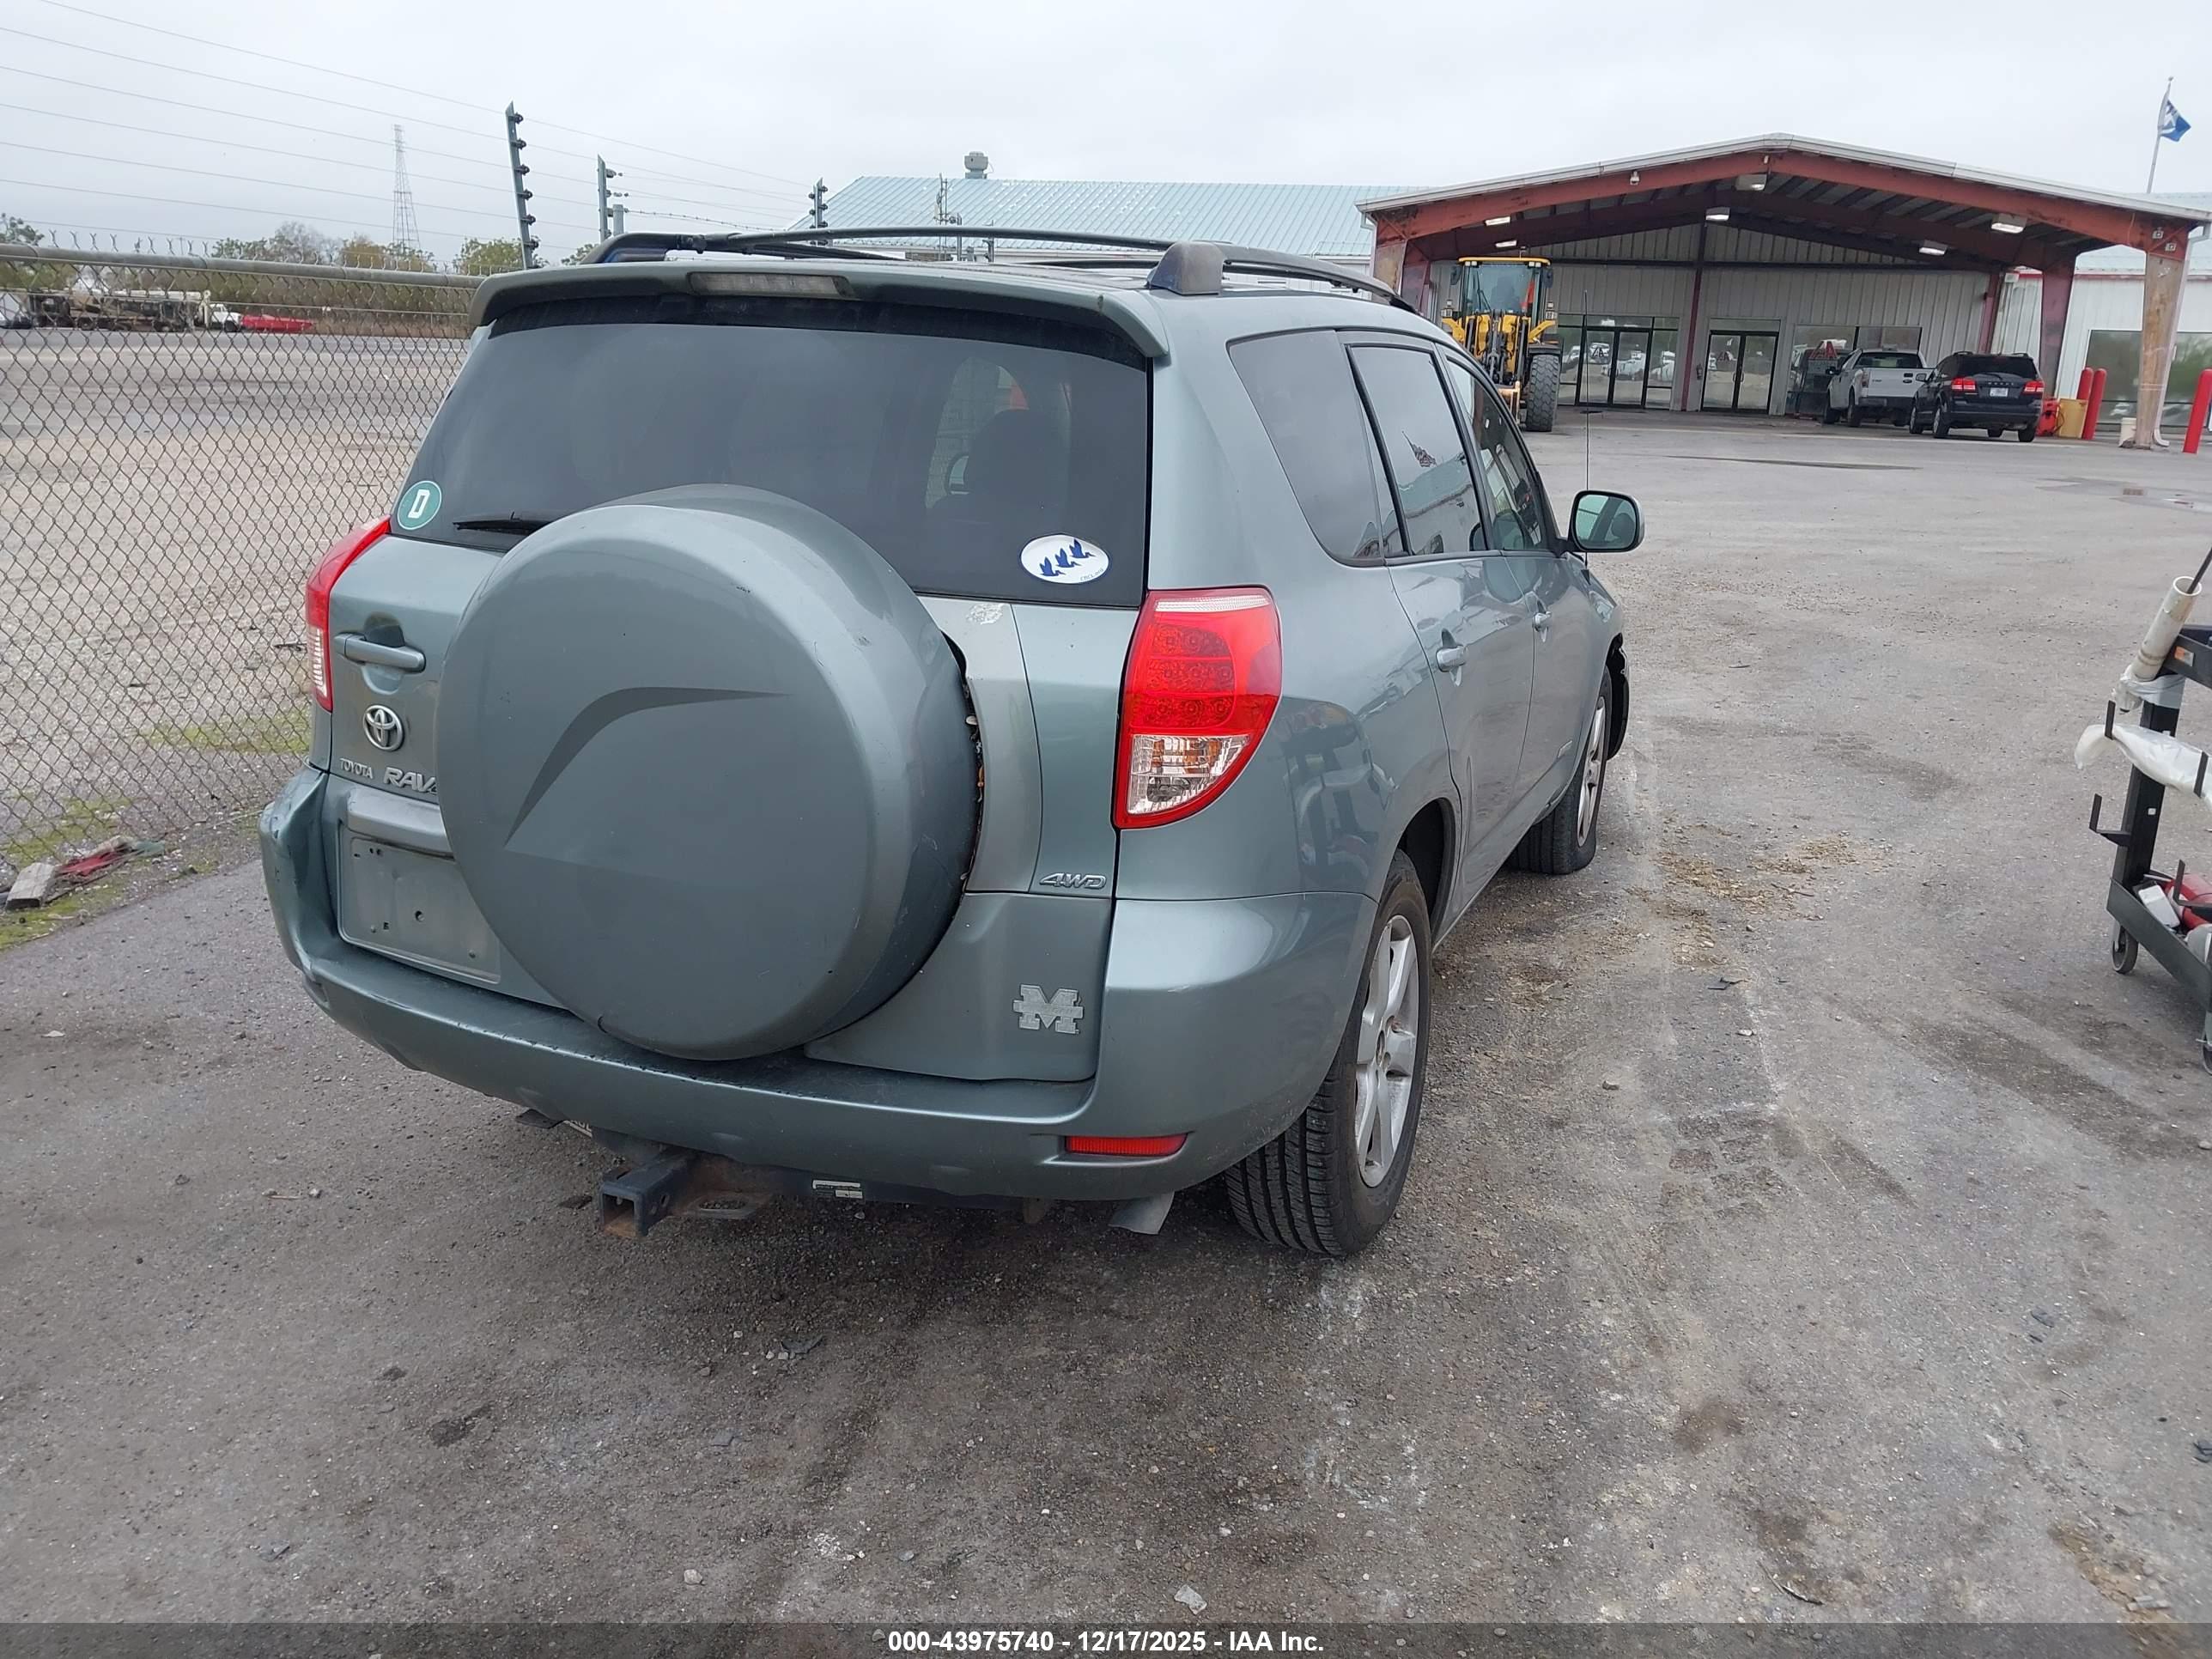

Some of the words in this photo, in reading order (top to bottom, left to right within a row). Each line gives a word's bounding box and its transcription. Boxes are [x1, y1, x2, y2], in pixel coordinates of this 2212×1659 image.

[408, 489, 430, 519] D
[340, 757, 373, 780] TOYOTA
[1039, 872, 1107, 890] 4WD
[1013, 984, 1084, 1034] M
